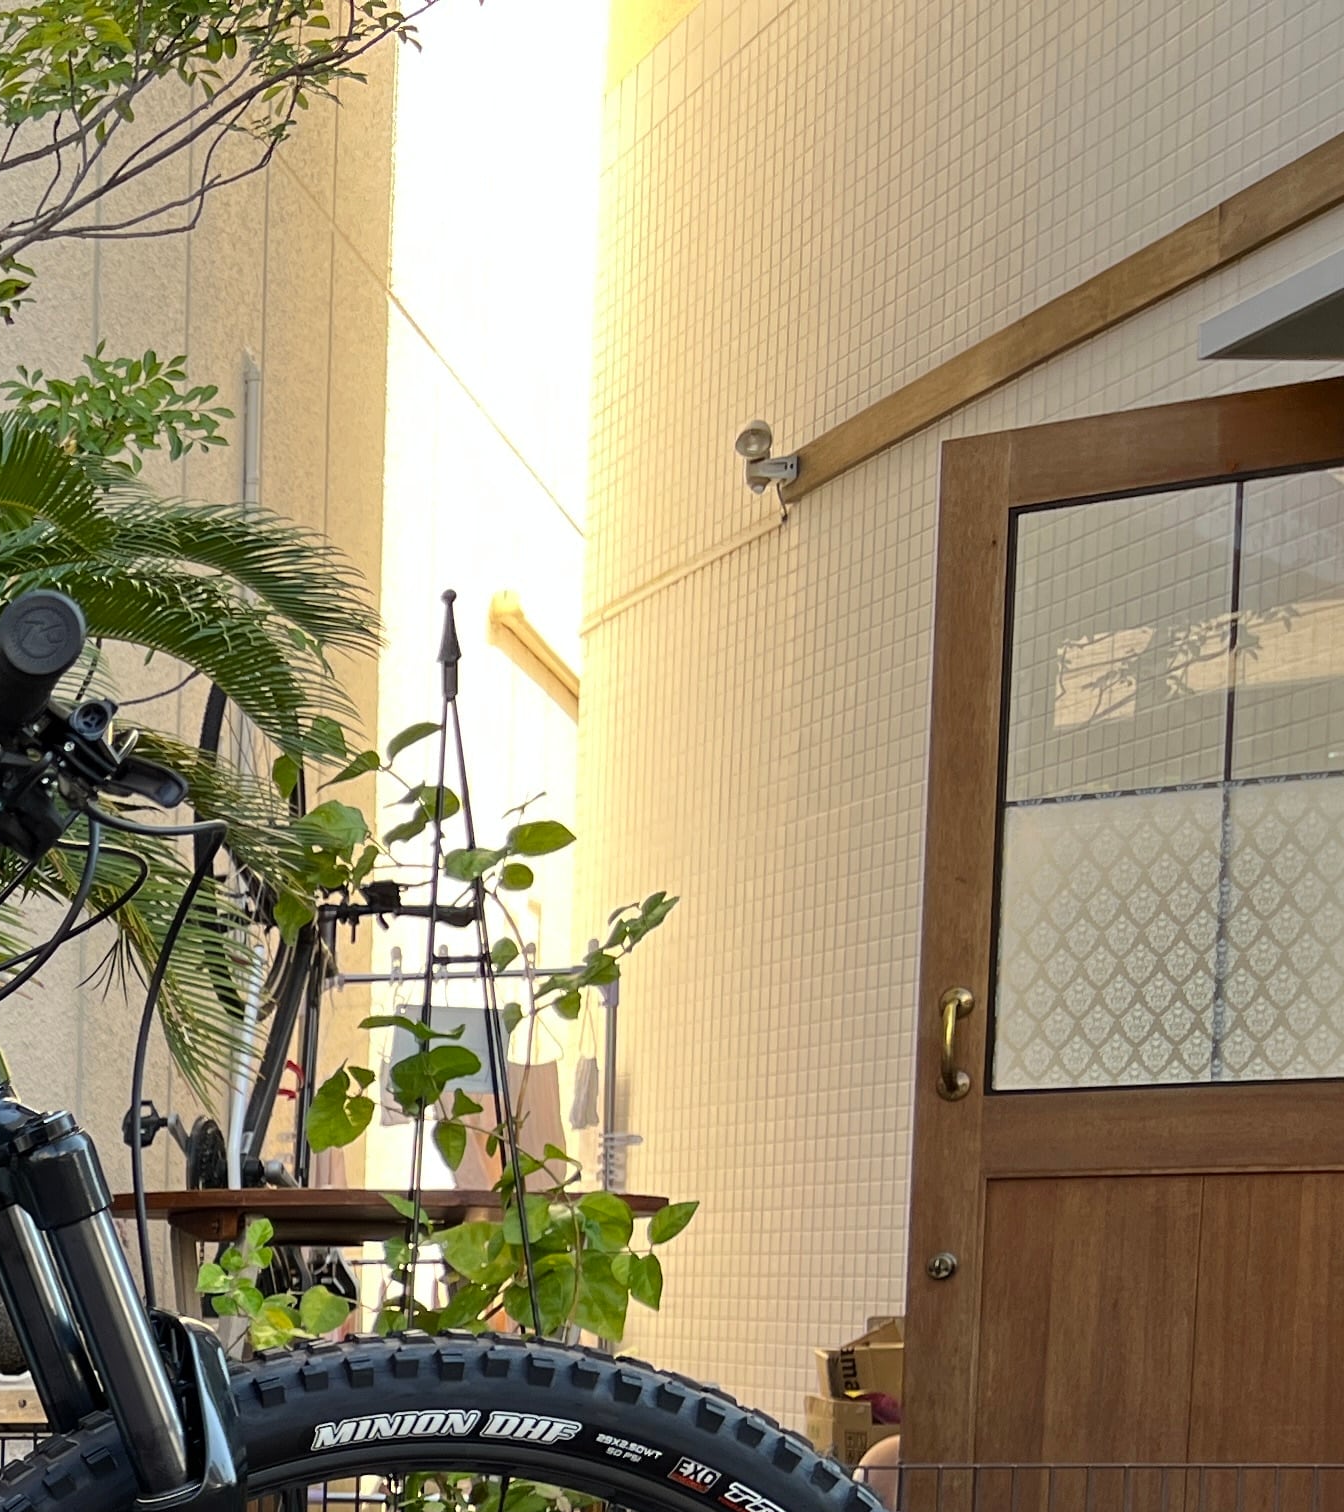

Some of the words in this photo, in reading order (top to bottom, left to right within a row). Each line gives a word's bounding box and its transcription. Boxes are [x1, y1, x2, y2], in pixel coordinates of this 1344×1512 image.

[311, 1409, 480, 1451] MINION
[480, 1410, 583, 1445] DHF
[676, 1457, 721, 1489] EXO
